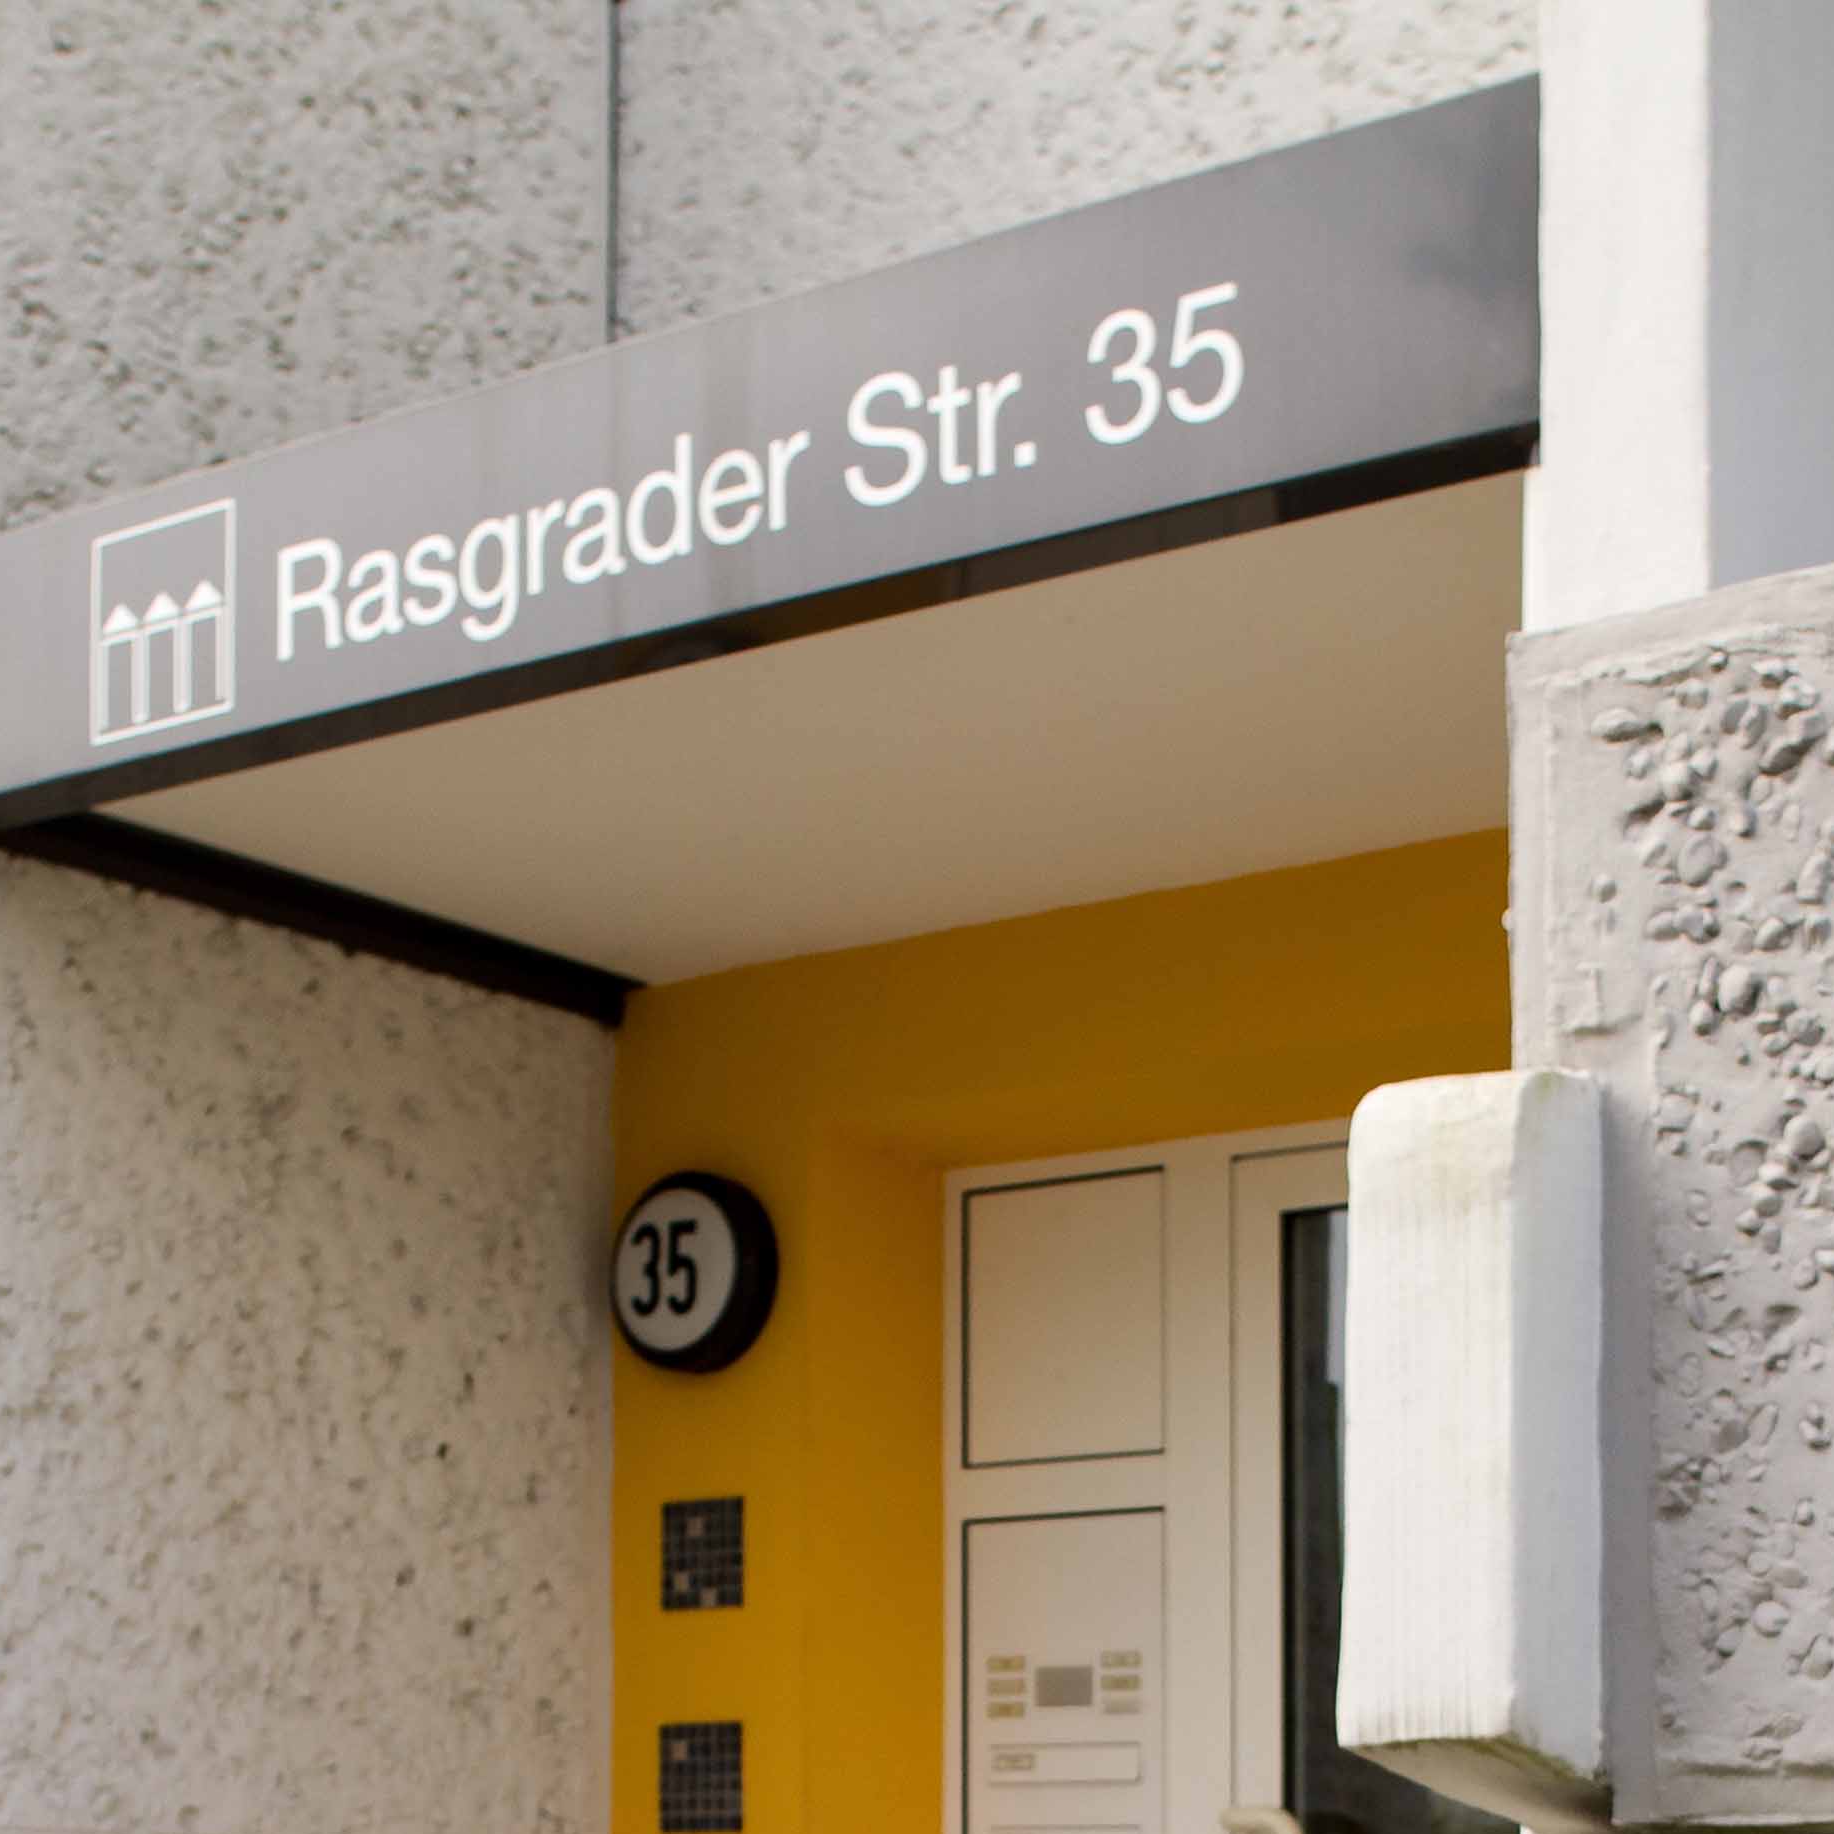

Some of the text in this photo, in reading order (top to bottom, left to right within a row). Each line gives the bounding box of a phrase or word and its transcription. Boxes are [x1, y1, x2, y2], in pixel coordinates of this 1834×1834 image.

[276, 281, 1245, 662] Rasgrader Str. 35
[630, 1217, 699, 1318] 35
